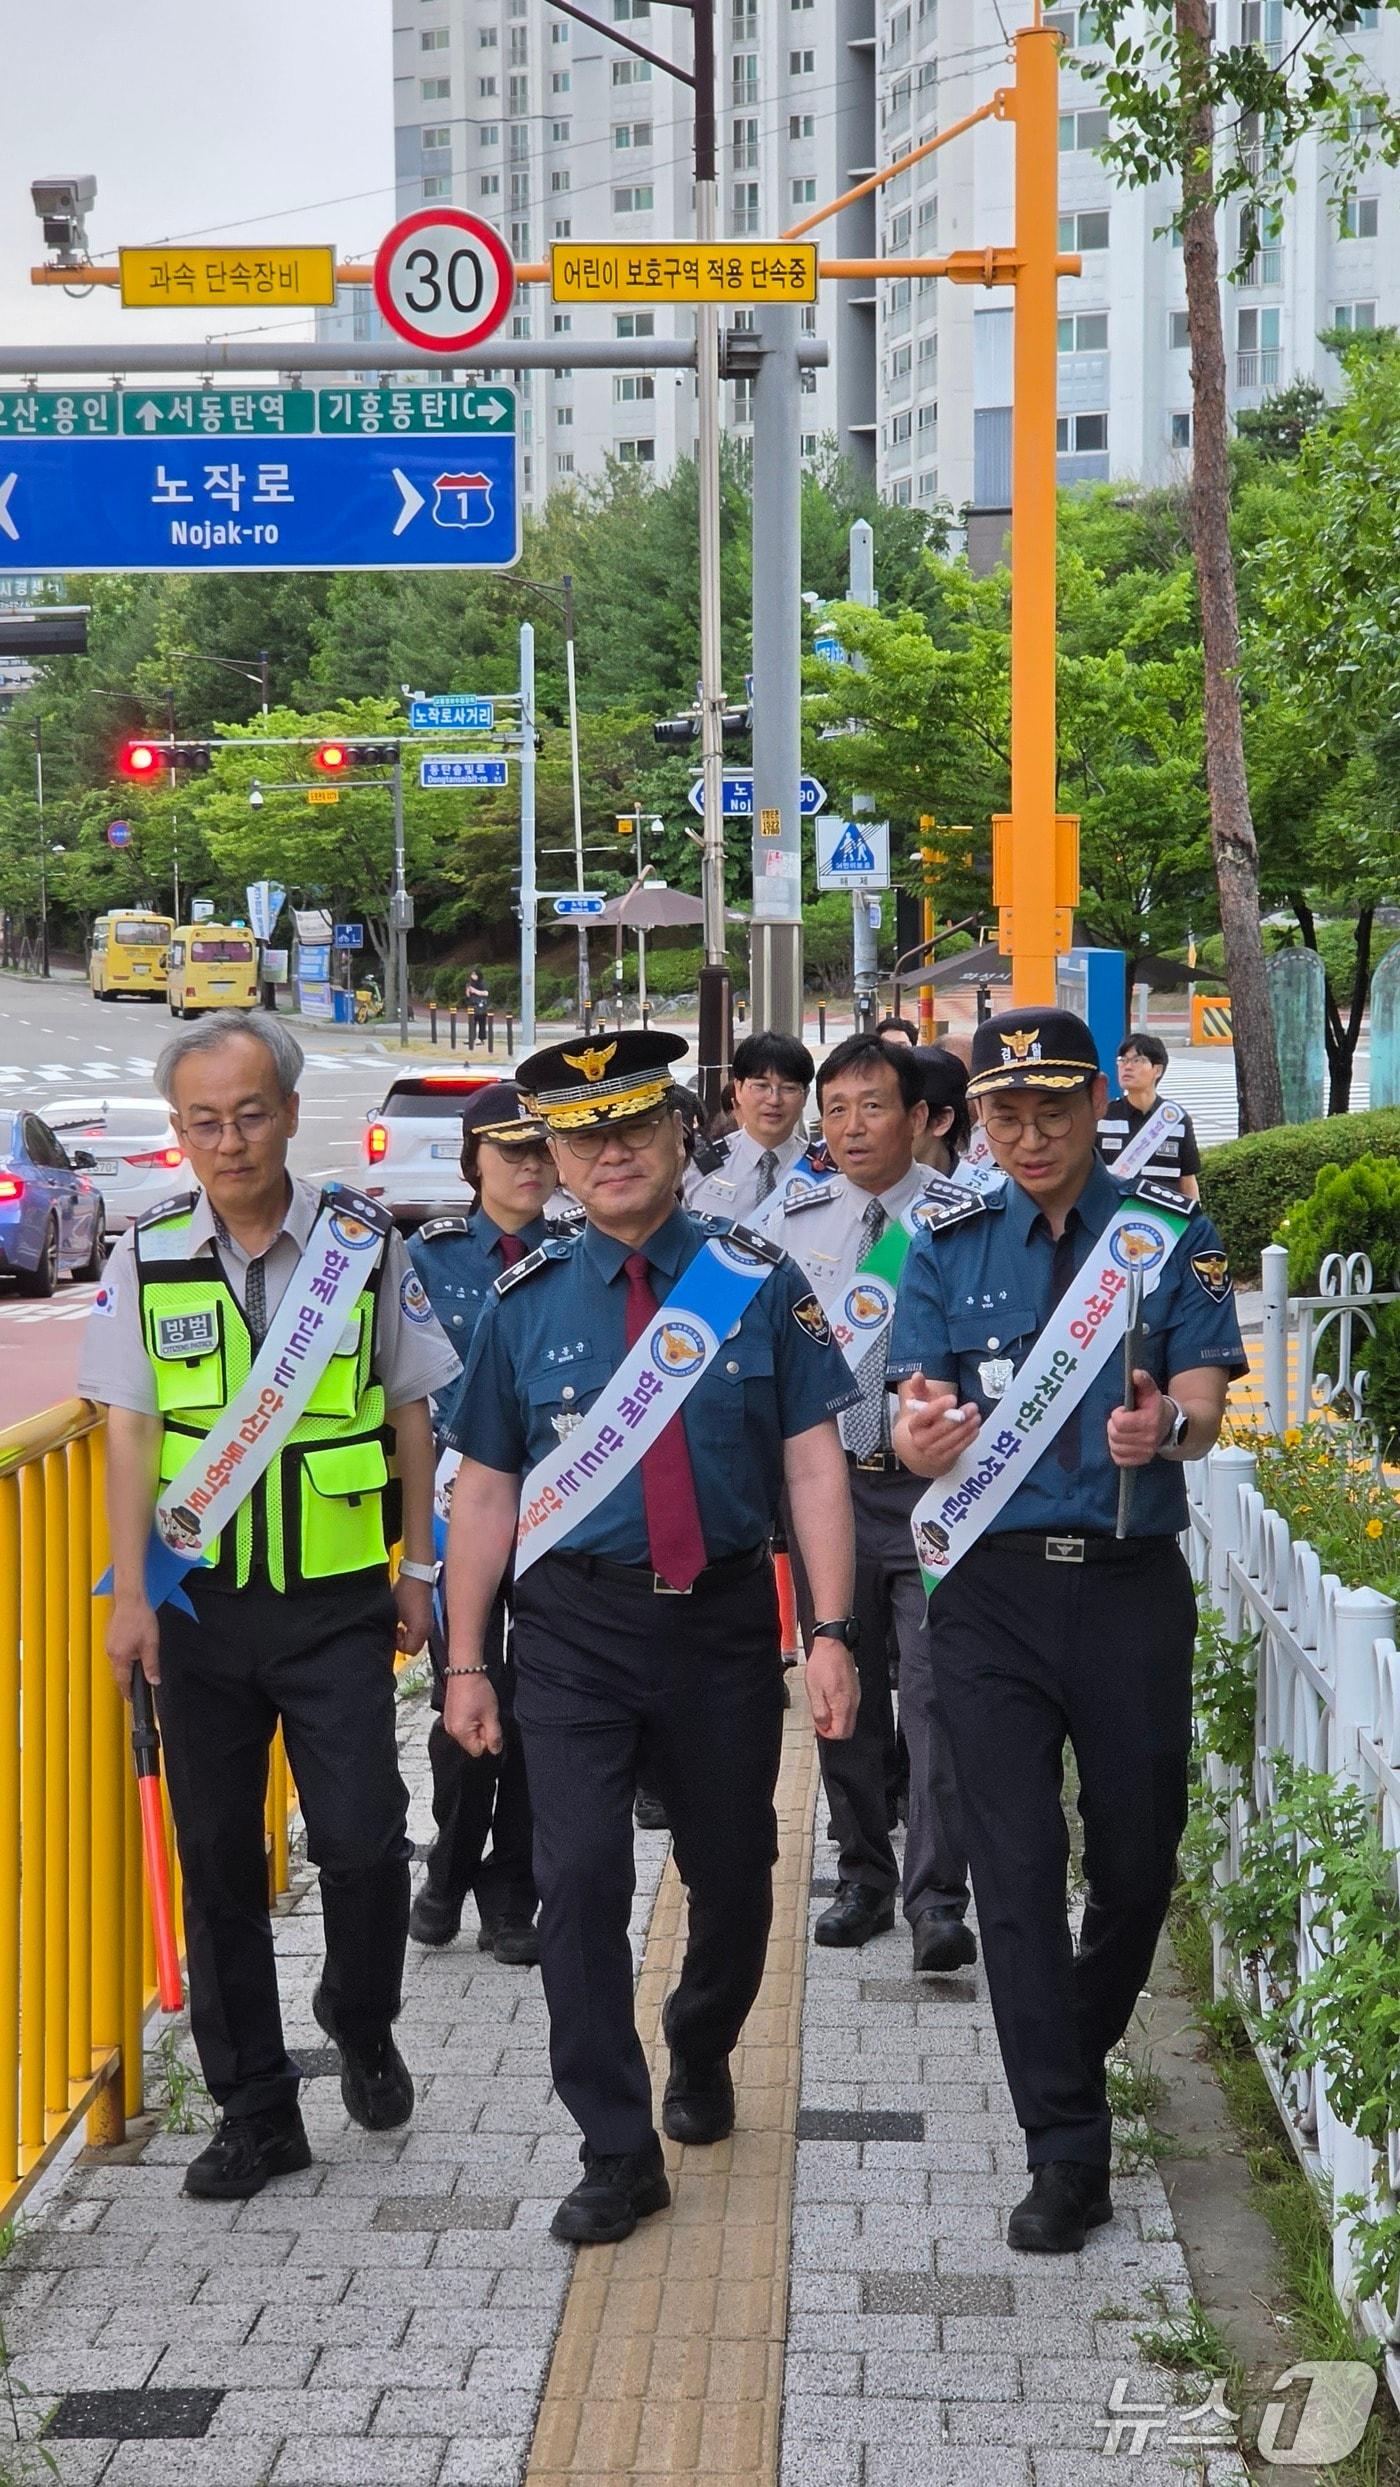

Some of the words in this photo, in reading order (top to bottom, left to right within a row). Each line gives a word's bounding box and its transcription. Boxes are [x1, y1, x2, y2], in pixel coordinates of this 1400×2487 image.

[150, 260, 196, 294] 과속
[206, 260, 299, 294] 단속장비
[405, 248, 484, 313] 30
[564, 257, 618, 289] 어린이
[626, 257, 699, 289] 보호구역
[707, 257, 744, 289] 적용
[751, 257, 807, 289] 단속중
[168, 394, 285, 433] 서동탄역
[329, 391, 476, 433] 기흥동탄IC
[151, 463, 295, 512] 노작로
[456, 492, 468, 520] 1
[171, 520, 279, 550] Nojak-ro
[415, 706, 491, 726] 노작로사거리
[346, 926, 353, 934] P
[309, 1249, 350, 1306] 함께
[166, 1315, 208, 1342] 방범
[1070, 1268, 1127, 1351] 학생의
[273, 1305, 324, 1389] 만드는
[239, 1387, 285, 1445] 안심
[617, 1370, 664, 1430] 함께
[1014, 1350, 1079, 1434] 안전한
[184, 1440, 248, 1516] 통학로
[555, 1424, 625, 1497] 만드는
[939, 1429, 1023, 1529] 화성동탄
